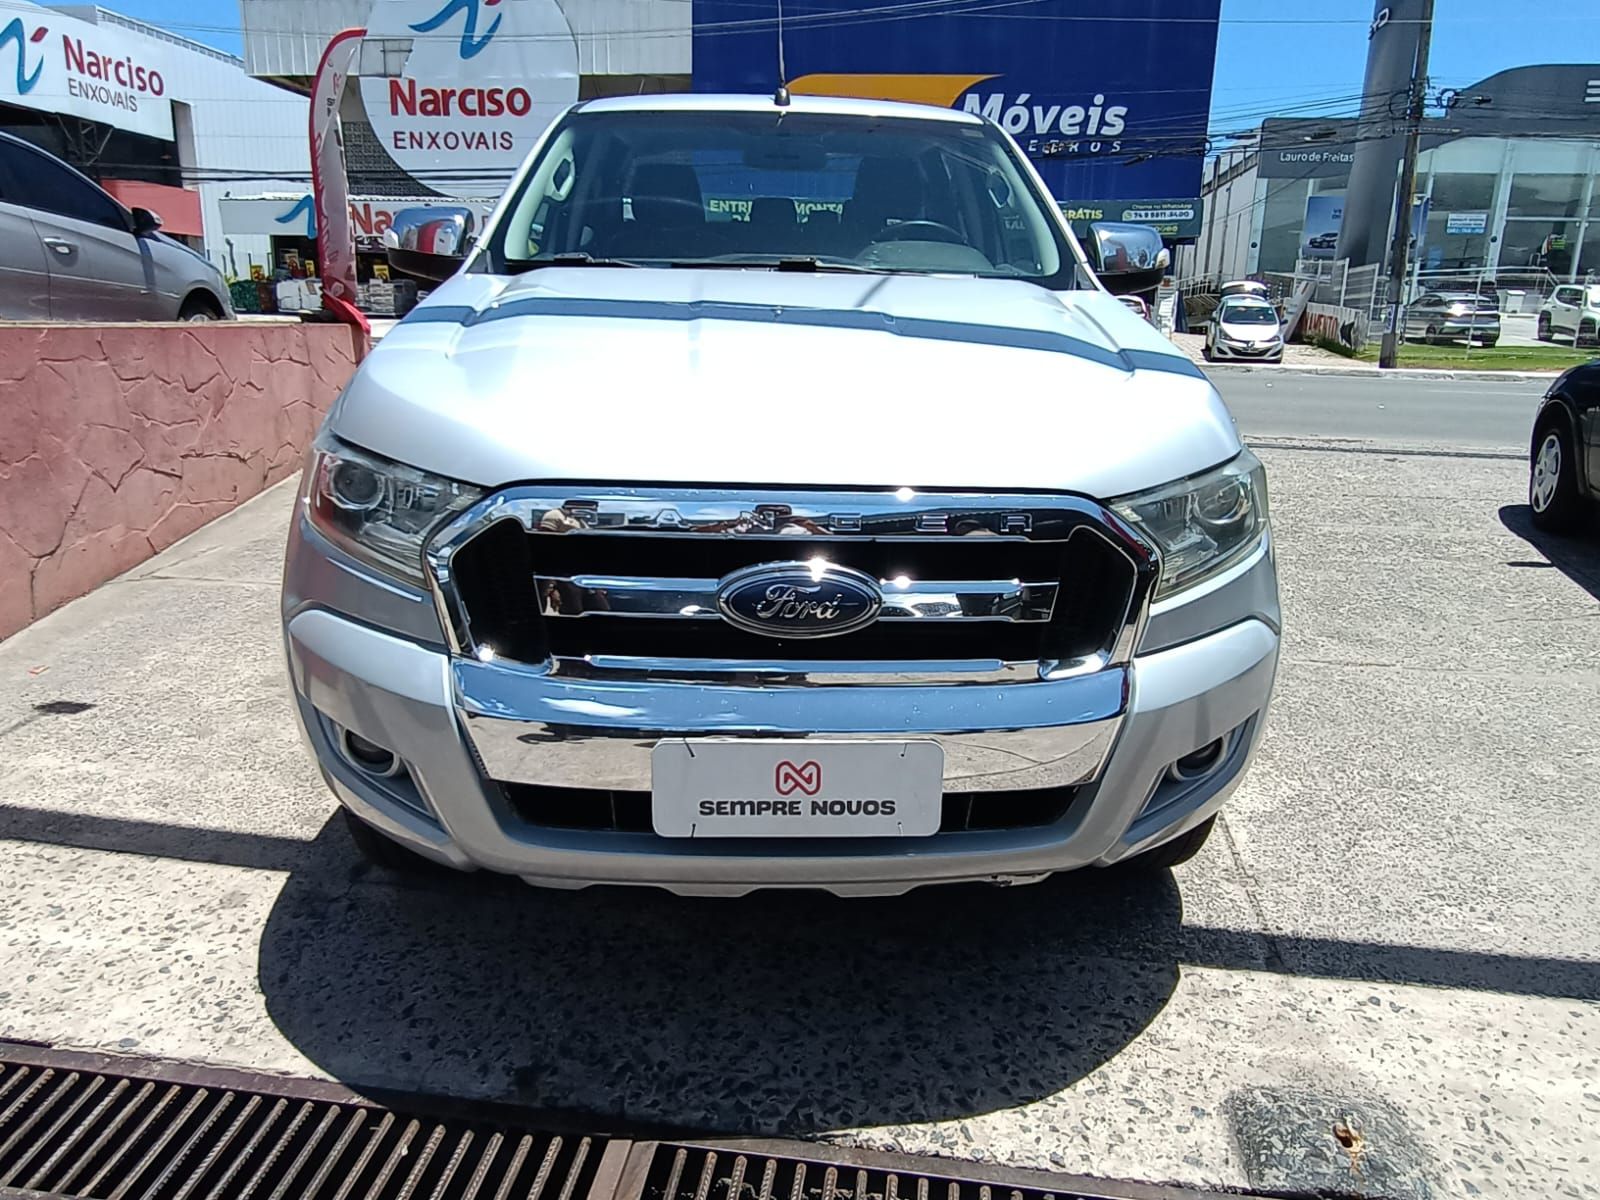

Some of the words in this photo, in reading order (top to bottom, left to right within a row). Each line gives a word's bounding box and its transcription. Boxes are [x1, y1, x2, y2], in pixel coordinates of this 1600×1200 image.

[62, 34, 164, 96] Narciso
[68, 78, 138, 112] ENXOVAIS
[389, 79, 531, 116] Narciso
[963, 93, 1128, 135] Móveis
[393, 131, 513, 150] ENXOVAIS
[1280, 152, 1308, 162] Lauro
[1308, 152, 1321, 162] de
[1322, 152, 1354, 162] Freitas
[755, 583, 842, 619] Ford
[699, 800, 802, 816] SEMPRE
[811, 800, 896, 816] NOVOS
